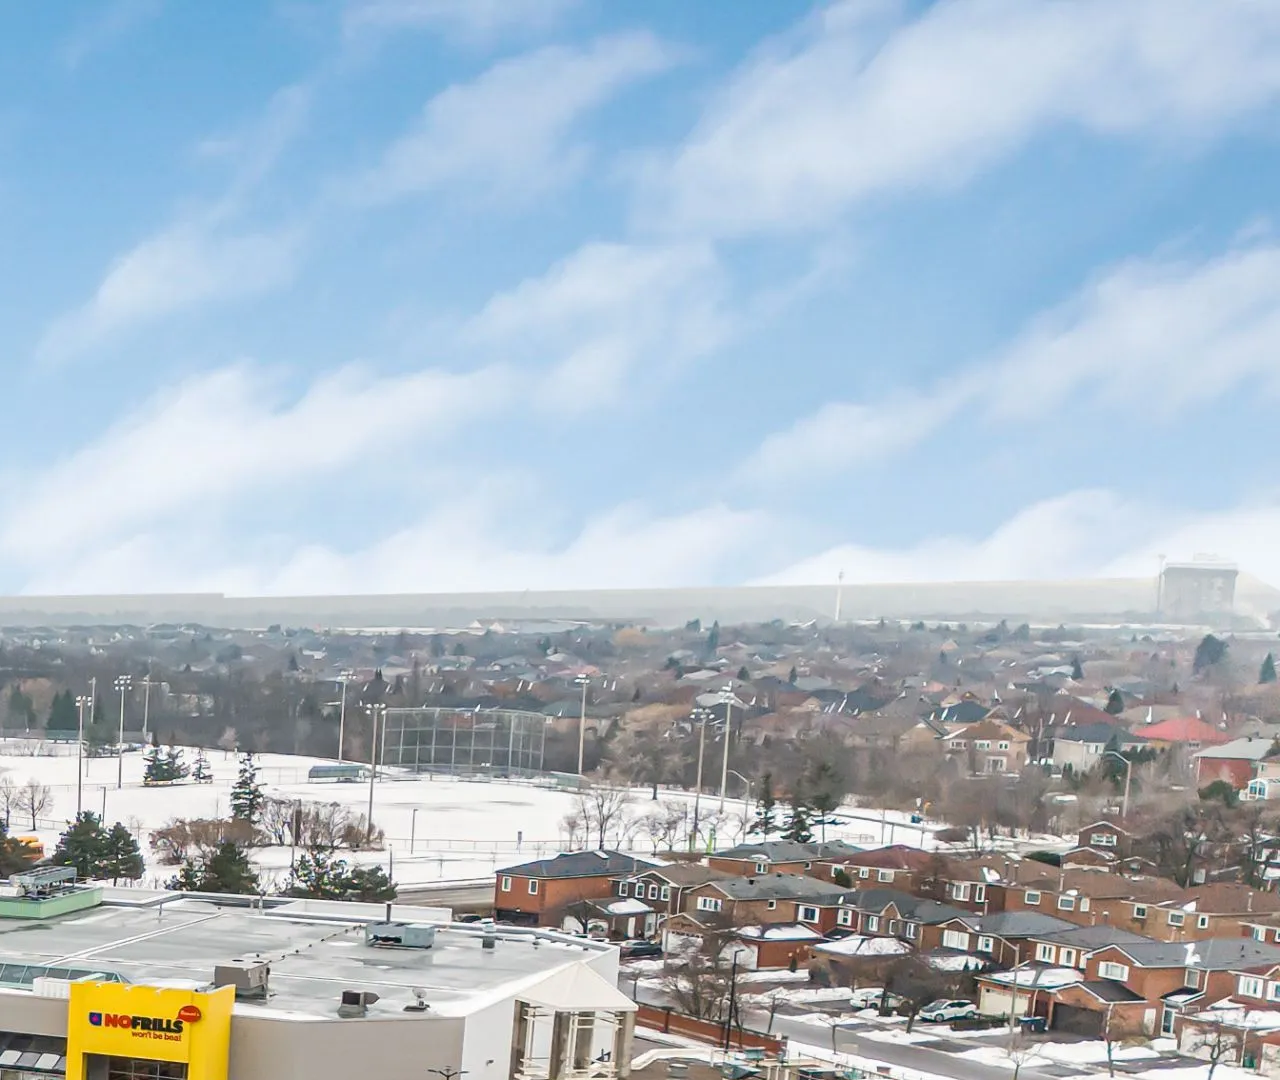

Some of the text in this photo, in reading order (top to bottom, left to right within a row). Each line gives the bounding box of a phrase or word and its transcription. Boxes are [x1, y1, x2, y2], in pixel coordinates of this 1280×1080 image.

[131, 1031, 182, 1042] won't be beat
